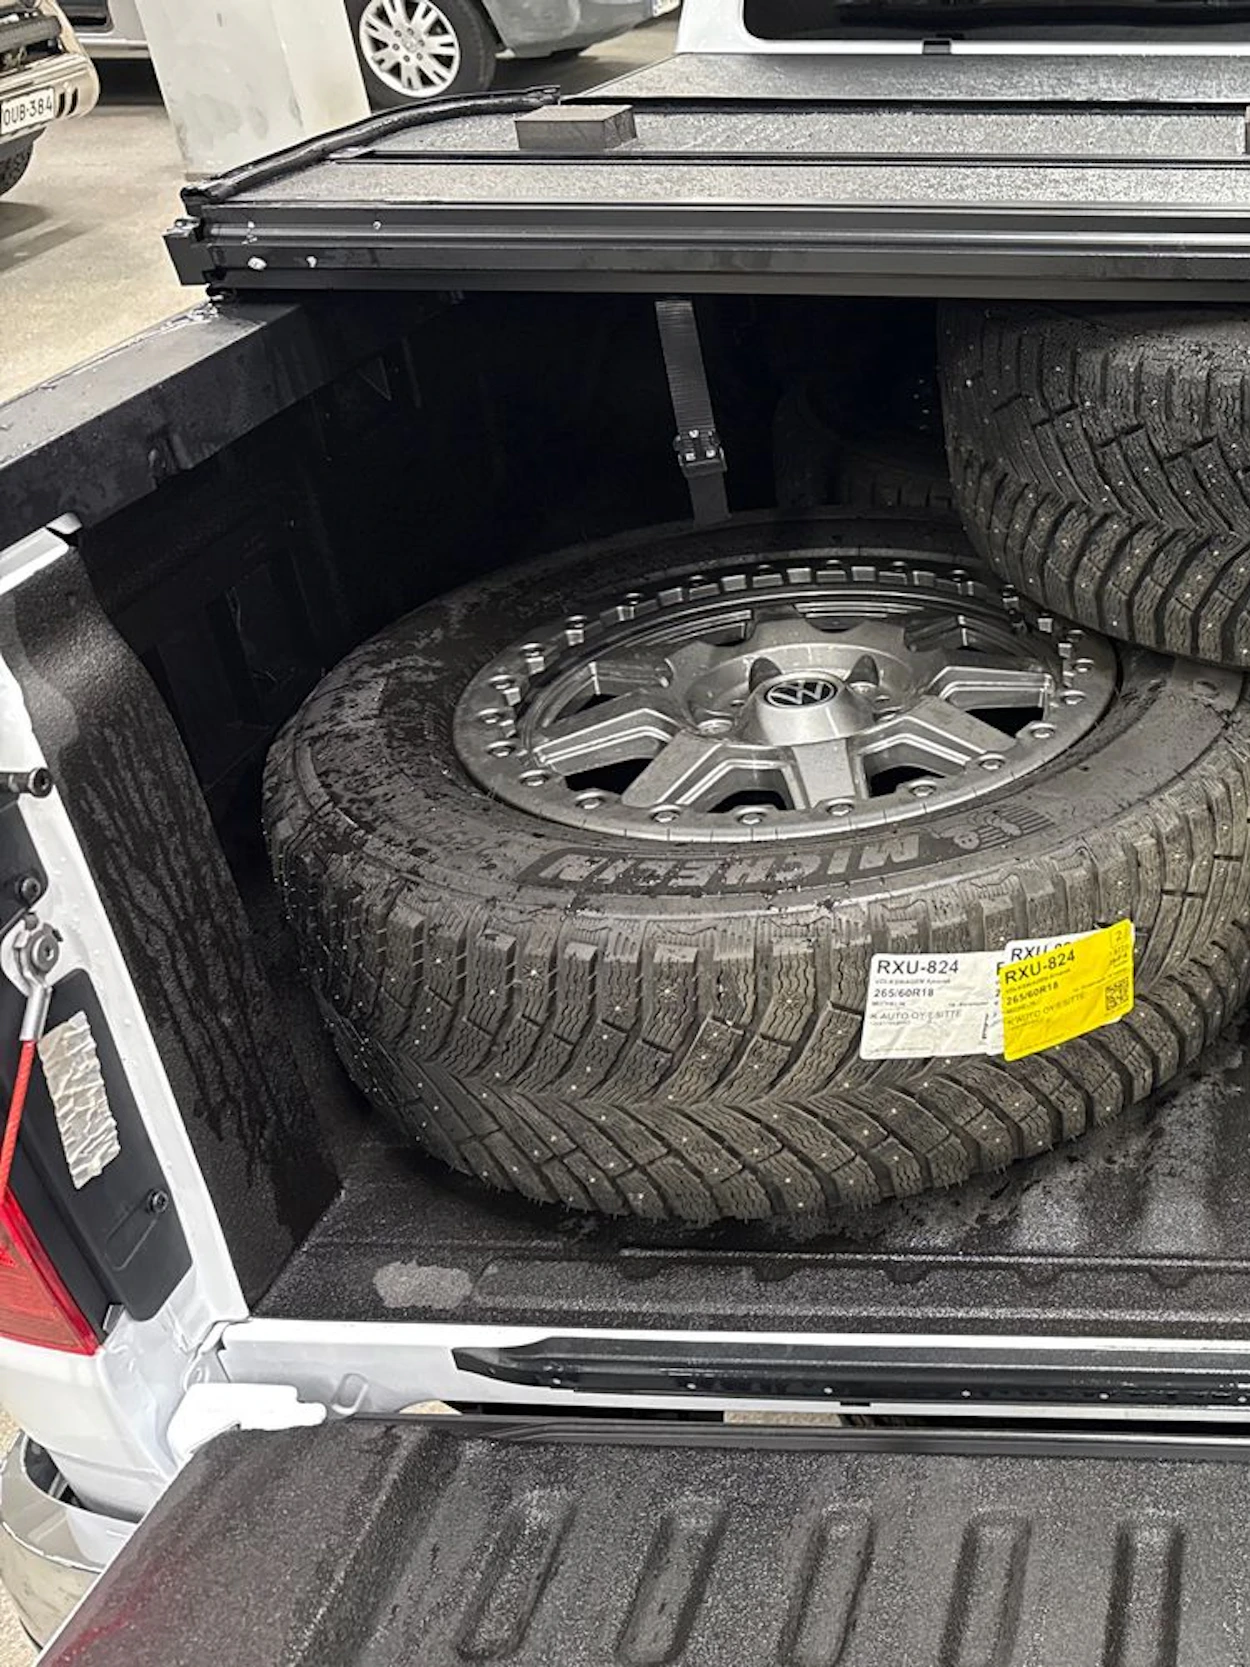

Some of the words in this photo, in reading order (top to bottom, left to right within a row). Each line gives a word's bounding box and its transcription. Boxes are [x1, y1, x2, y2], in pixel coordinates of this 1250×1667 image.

[3, 95, 52, 126] OUB-384
[538, 834, 921, 887] MICHELIN
[876, 959, 959, 975] RXU-824
[1005, 951, 1075, 984] RXU-824
[873, 988, 934, 998] 265/60R18
[1005, 982, 1059, 1006] 265/60R18
